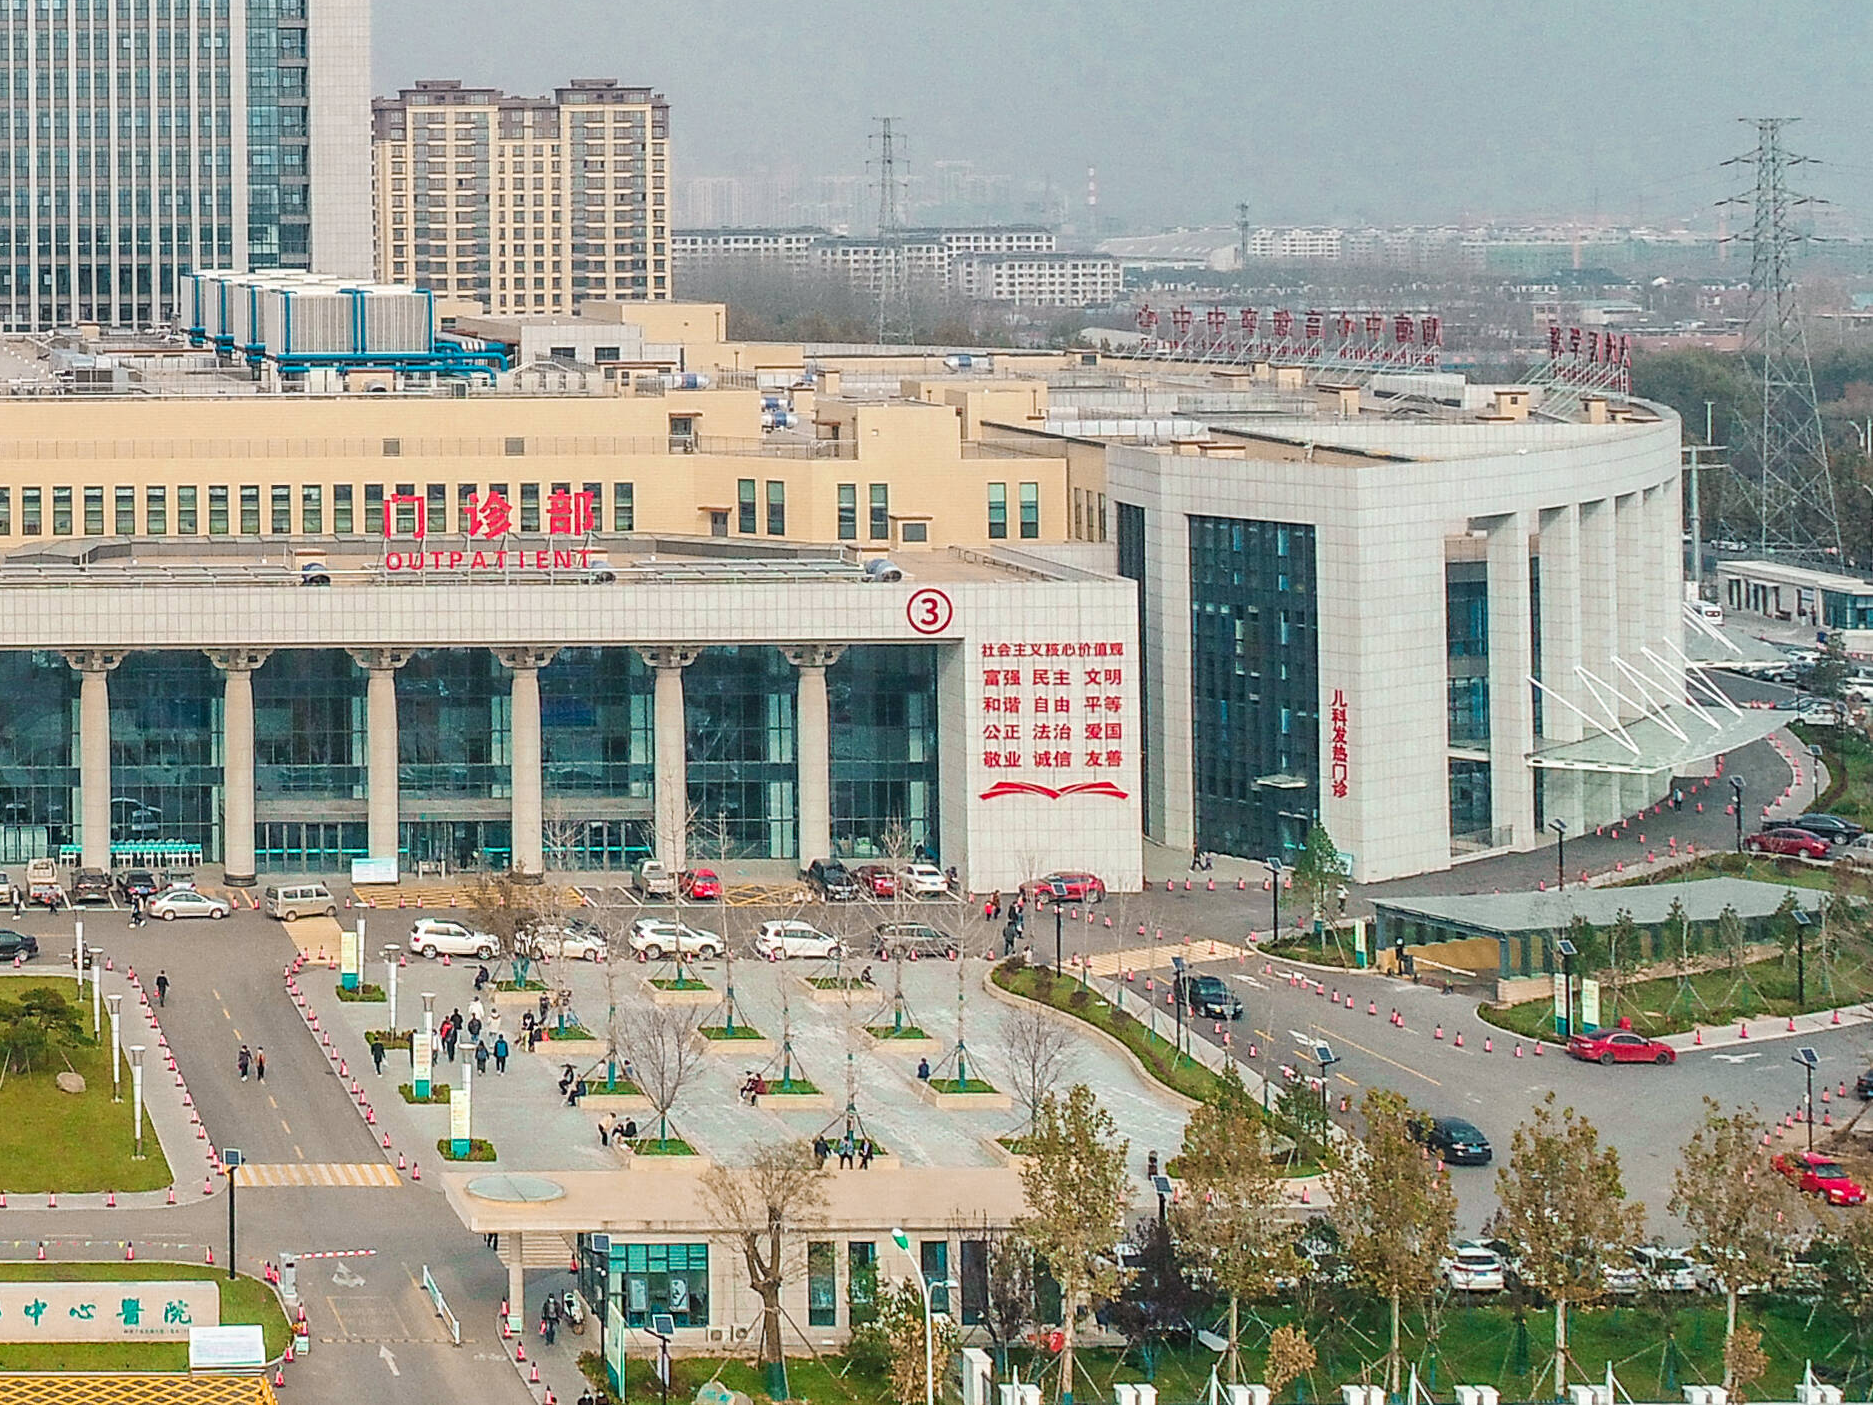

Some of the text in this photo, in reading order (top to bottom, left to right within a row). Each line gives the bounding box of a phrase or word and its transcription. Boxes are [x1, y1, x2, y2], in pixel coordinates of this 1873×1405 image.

[383, 488, 595, 540] 门诊部
[385, 549, 595, 571] OUTPATIENT
[981, 642, 1124, 658] 社会主义核心价值观
[983, 668, 1123, 687] 富强 民主 文明
[983, 695, 1123, 714] 和谐 自由 平等
[983, 722, 1123, 740] 公正 法治 爱国
[1331, 689, 1349, 799] 儿科发热门诊
[983, 750, 1123, 768] 敬业 诚信 友善
